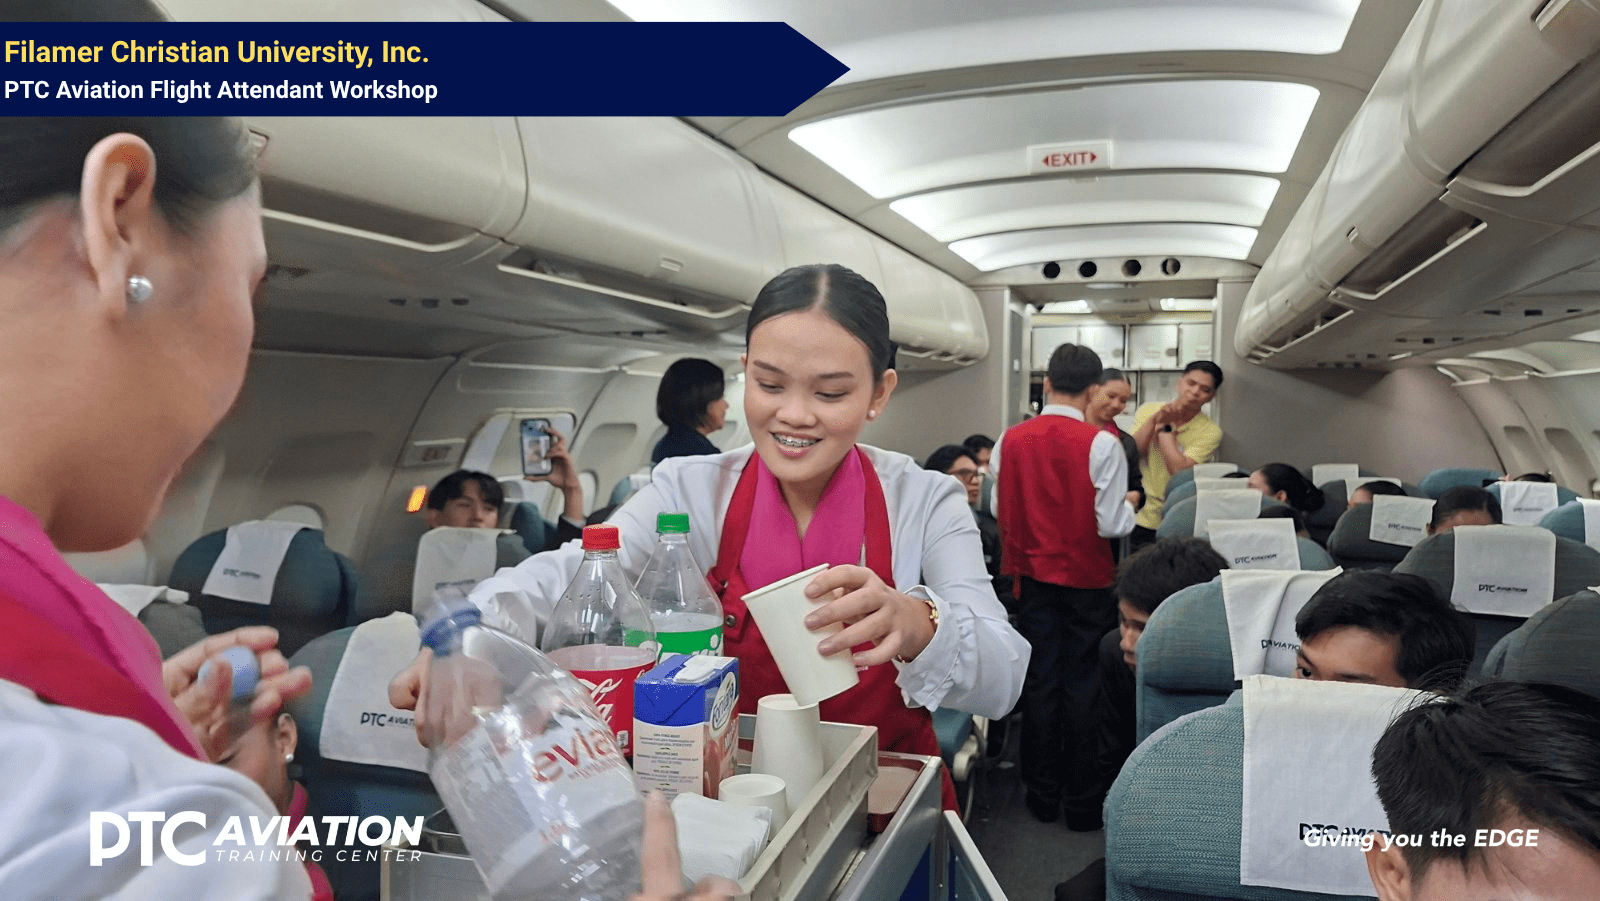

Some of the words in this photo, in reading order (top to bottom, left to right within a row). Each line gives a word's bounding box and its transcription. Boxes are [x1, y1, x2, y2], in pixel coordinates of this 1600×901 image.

[1051, 151, 1088, 167] EXIT
[1479, 584, 1495, 592] PTC
[361, 712, 386, 727] PTC
